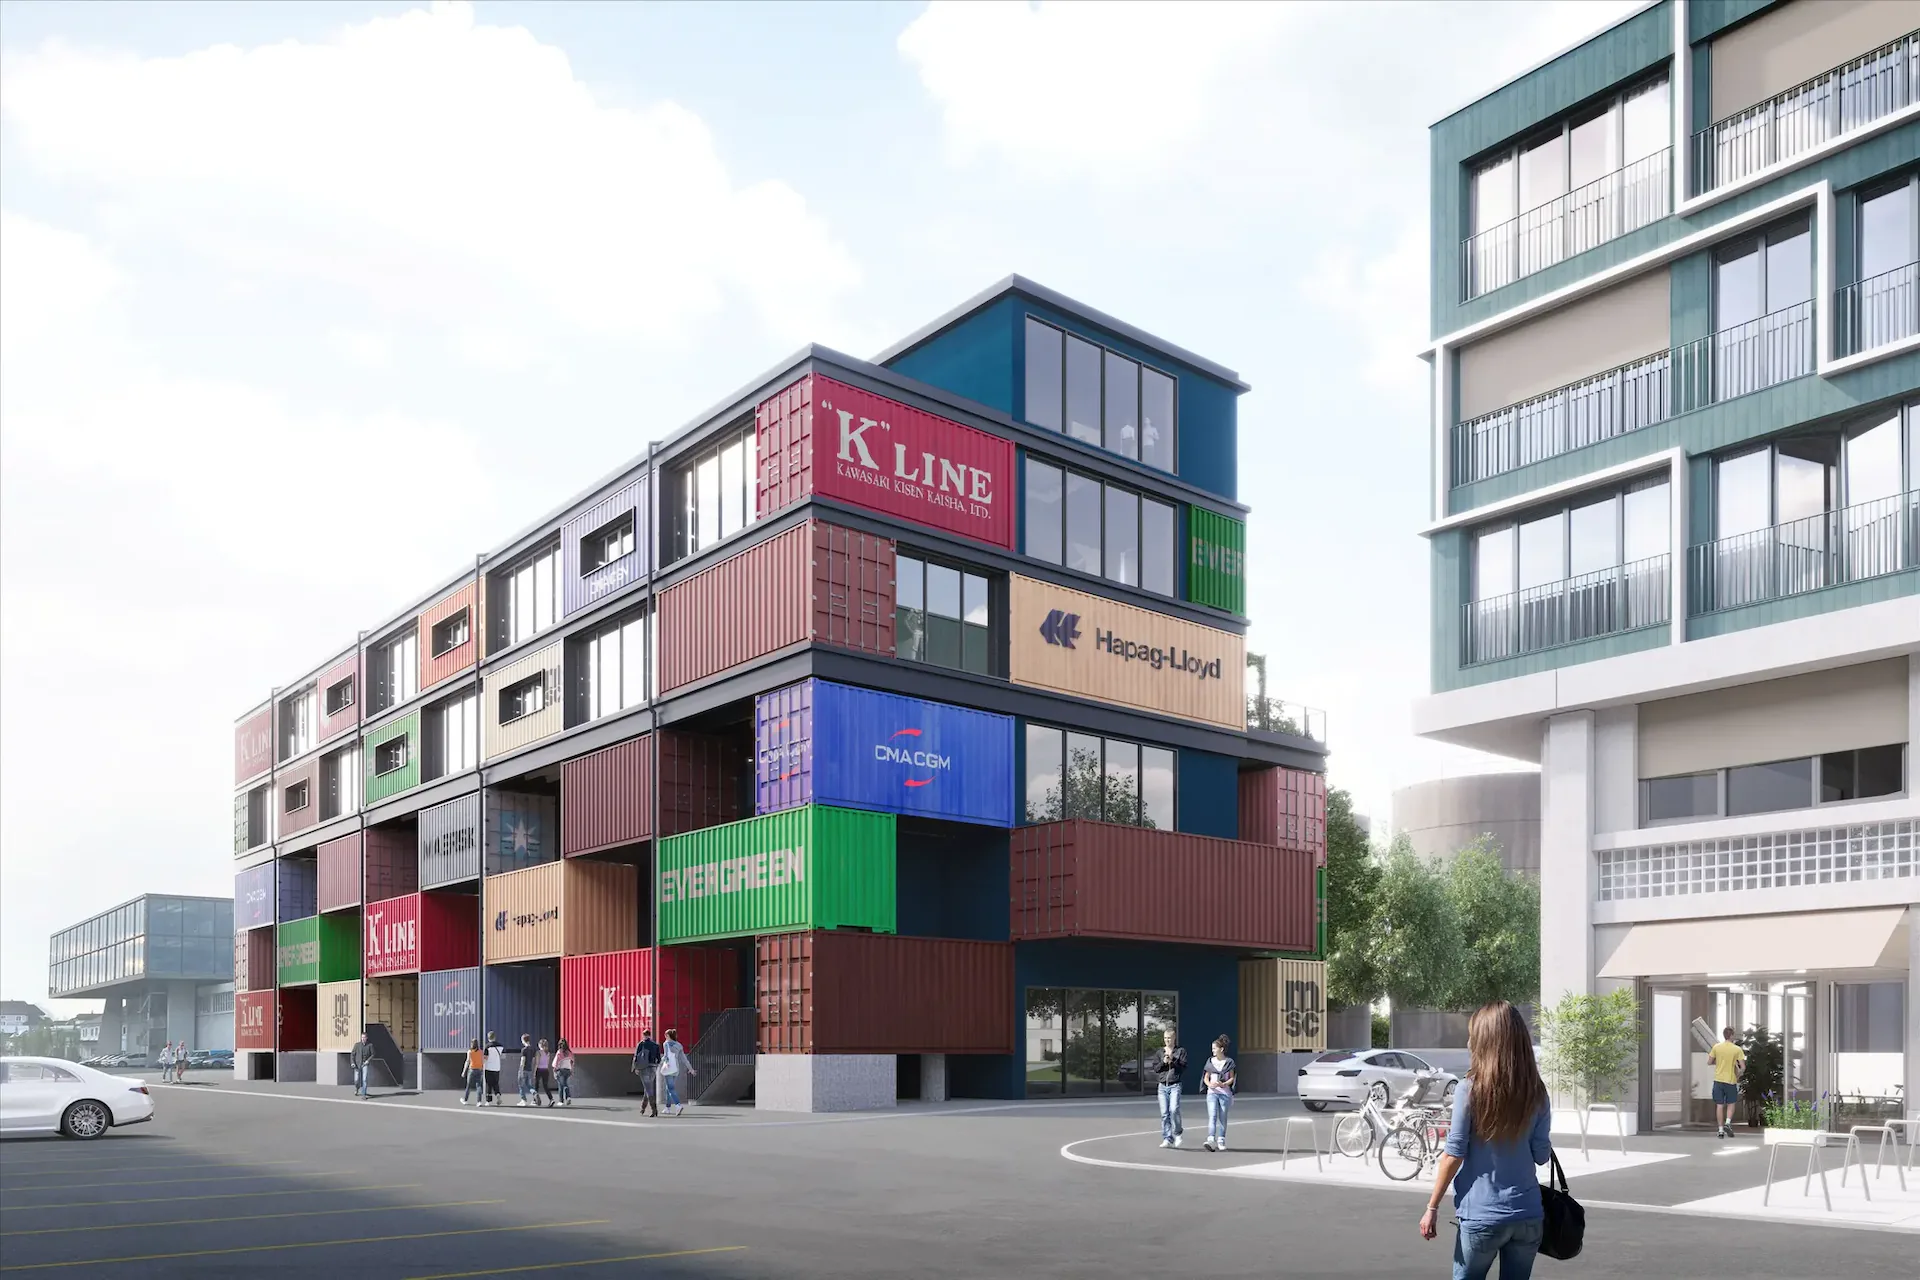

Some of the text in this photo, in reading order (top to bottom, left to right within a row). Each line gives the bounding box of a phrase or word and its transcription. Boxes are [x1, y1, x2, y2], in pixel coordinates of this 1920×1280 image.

[836, 461, 992, 520] KAWASAKI KISEN KAISHA, LTD.
[894, 442, 993, 504] LINE
[1095, 627, 1222, 680] Hapag-Lloyd
[874, 744, 951, 771] CMA CGM
[660, 845, 804, 904] EVERGREEN
[384, 919, 416, 954] LINE
[621, 994, 653, 1019] LINE
